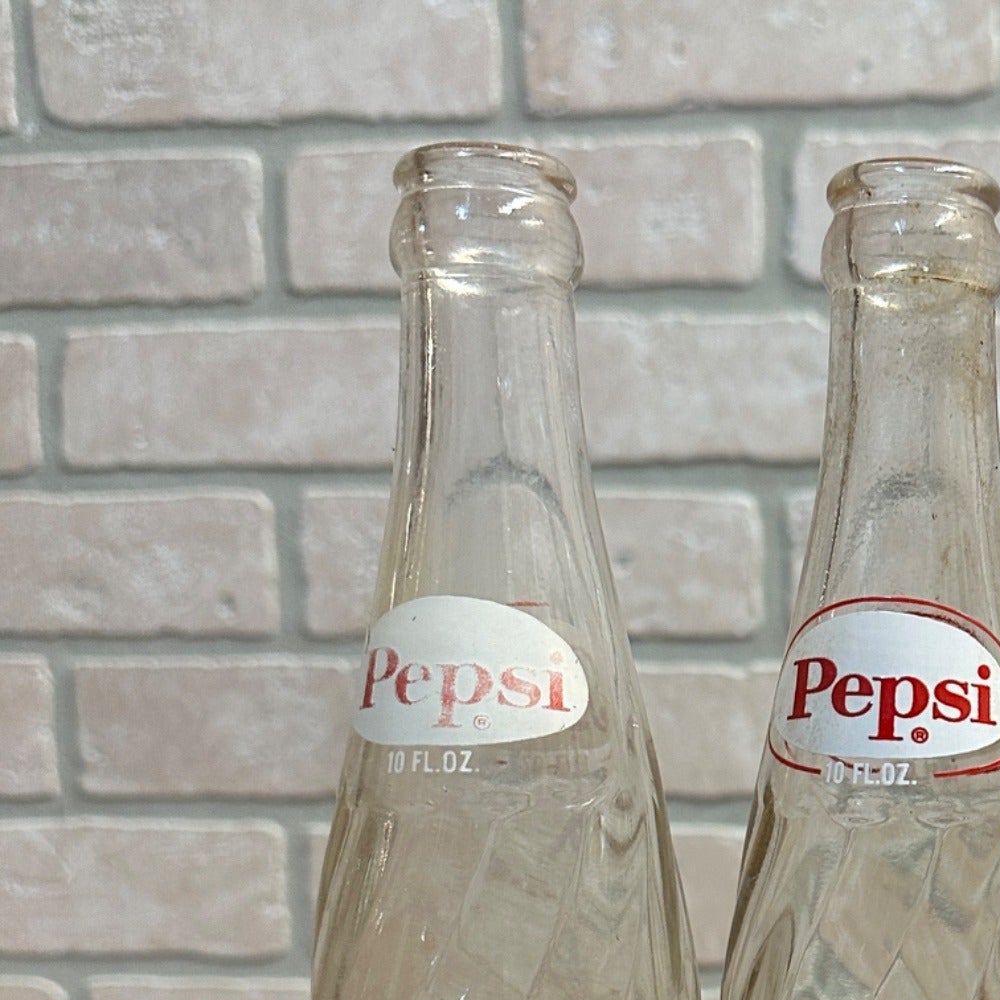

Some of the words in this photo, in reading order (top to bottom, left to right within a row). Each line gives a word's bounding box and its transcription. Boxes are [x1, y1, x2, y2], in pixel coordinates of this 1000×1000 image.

[359, 647, 571, 728] Pepsi
[787, 657, 997, 741] Pepsi
[387, 751, 405, 773] 10
[825, 762, 845, 784] 10
